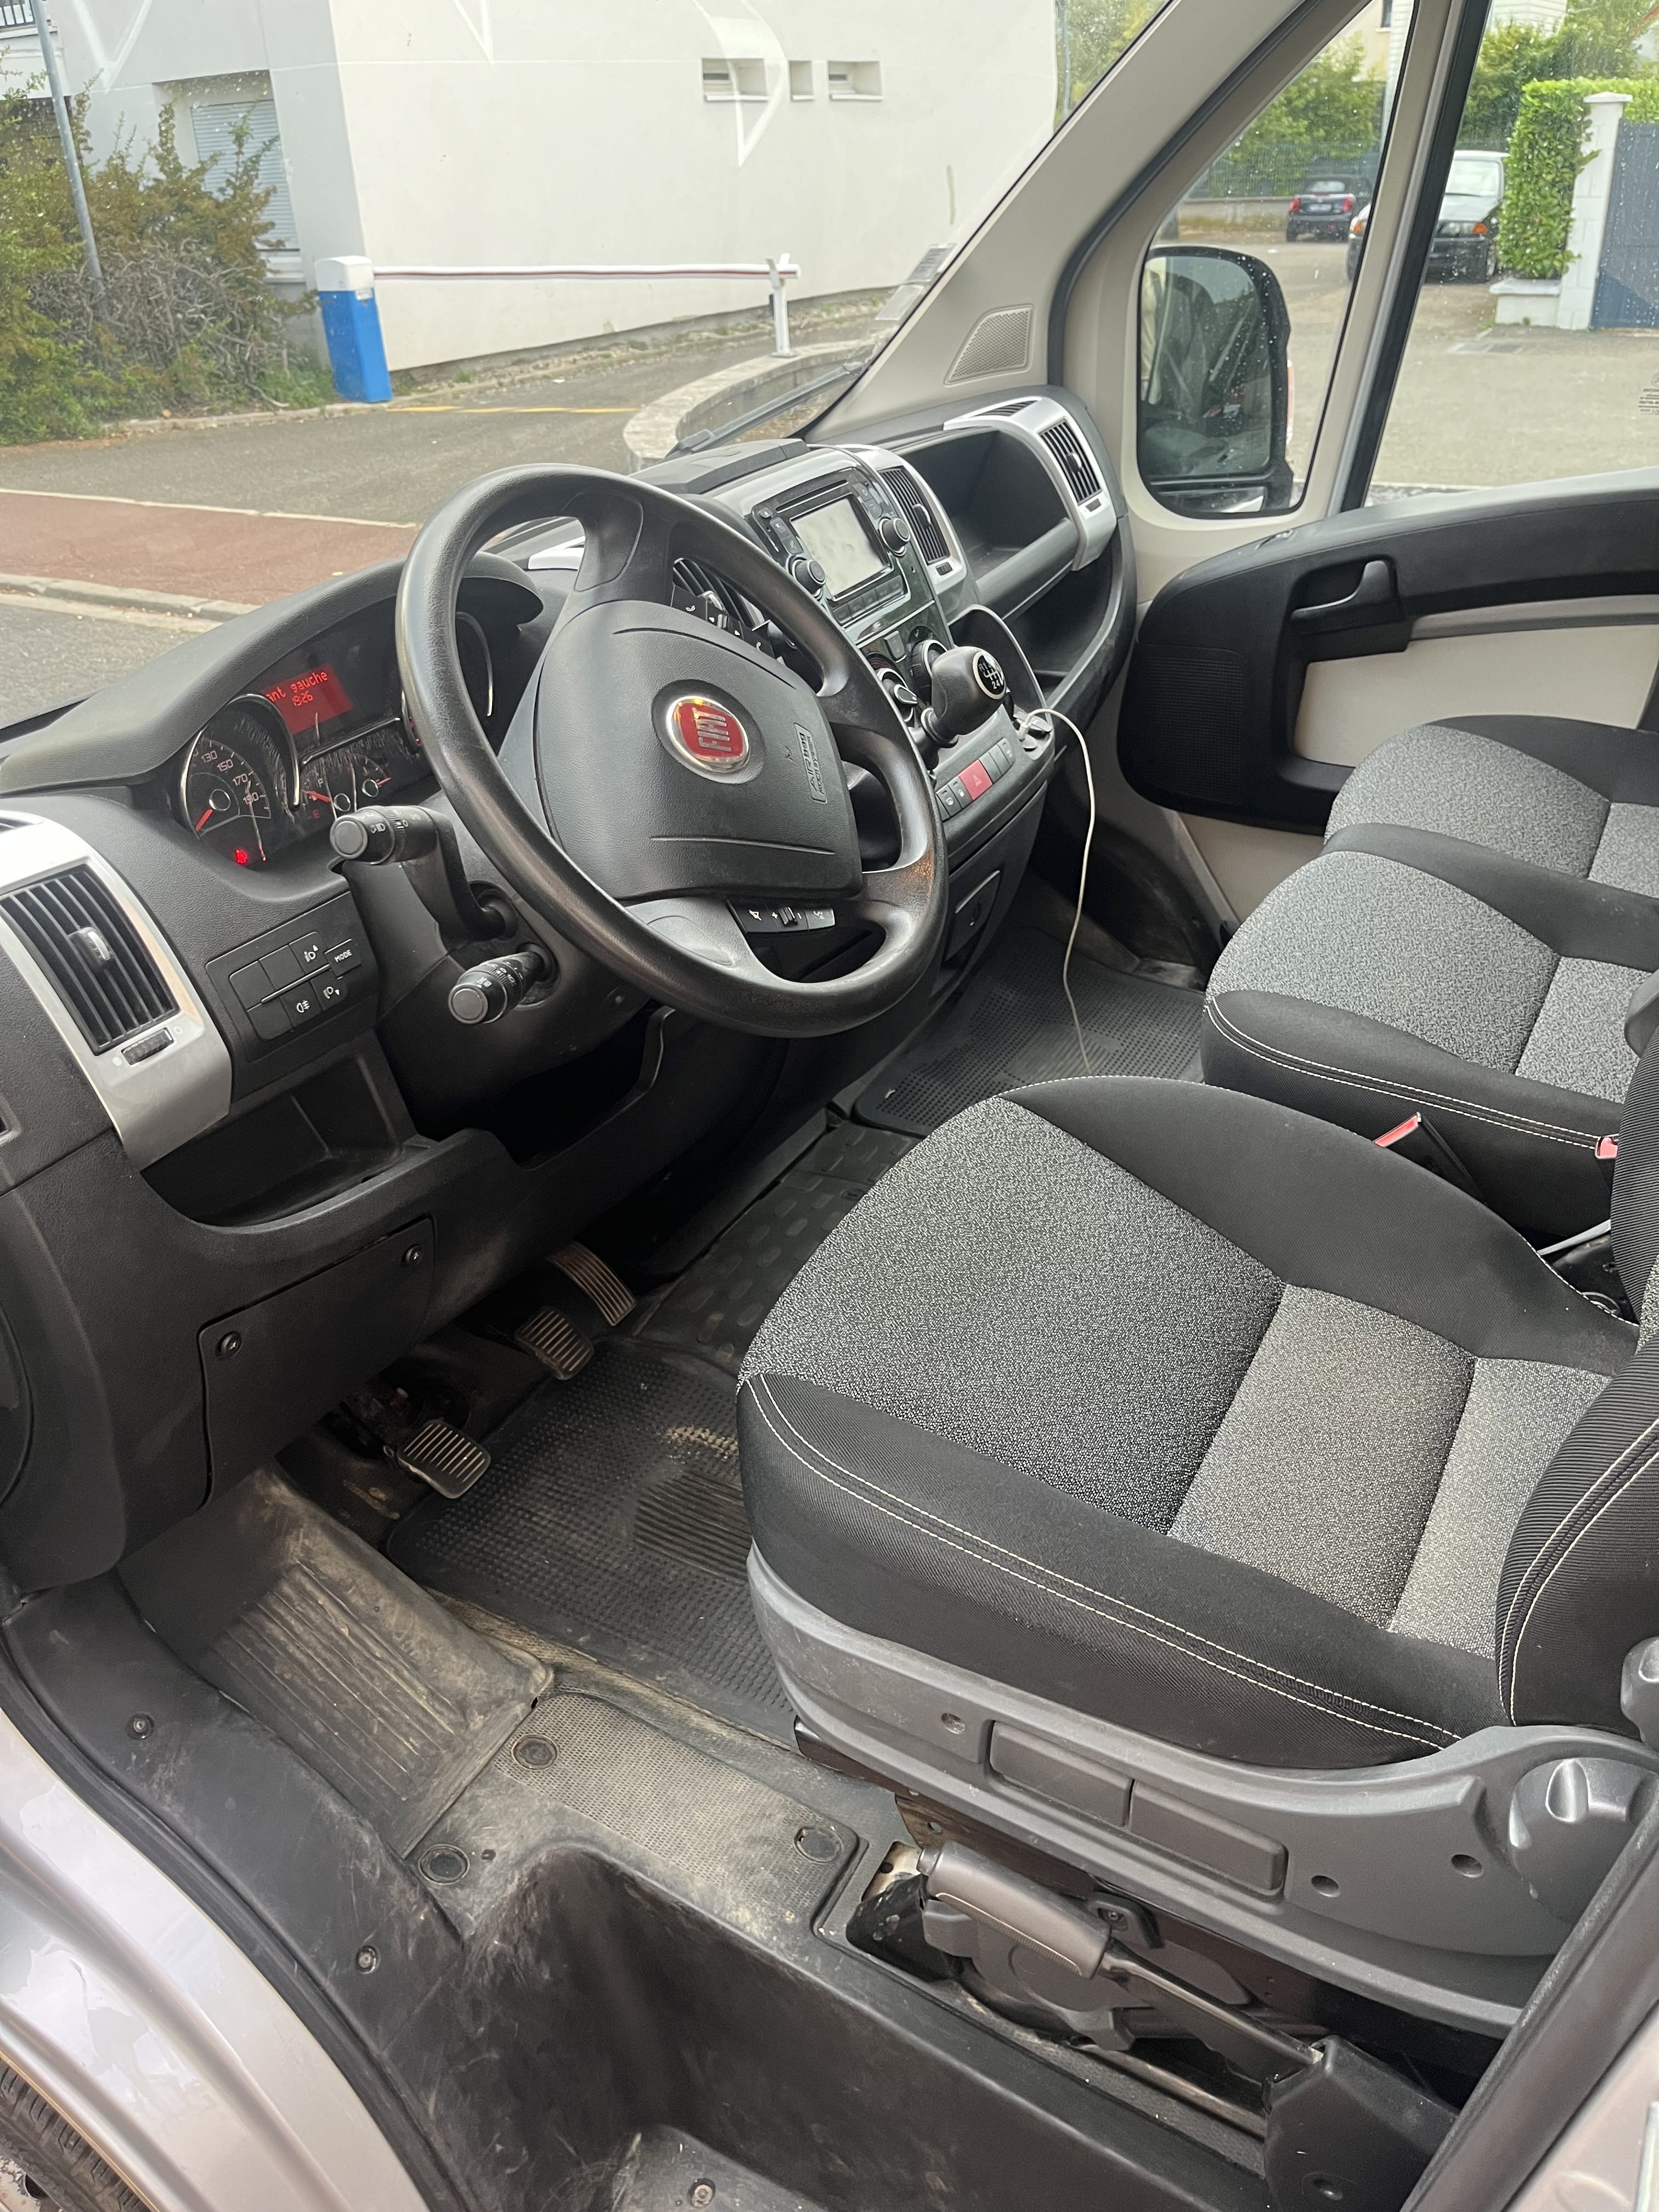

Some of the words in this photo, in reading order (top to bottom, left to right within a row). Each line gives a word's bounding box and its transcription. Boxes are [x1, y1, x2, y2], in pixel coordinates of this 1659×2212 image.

[290, 672, 328, 692] gauche
[991, 681, 997, 690] 2
[692, 707, 732, 752] FIAT
[201, 750, 218, 763] 130
[217, 759, 234, 772] 150
[233, 774, 248, 786] 170
[242, 792, 259, 805] 190
[334, 950, 352, 962] MODE
